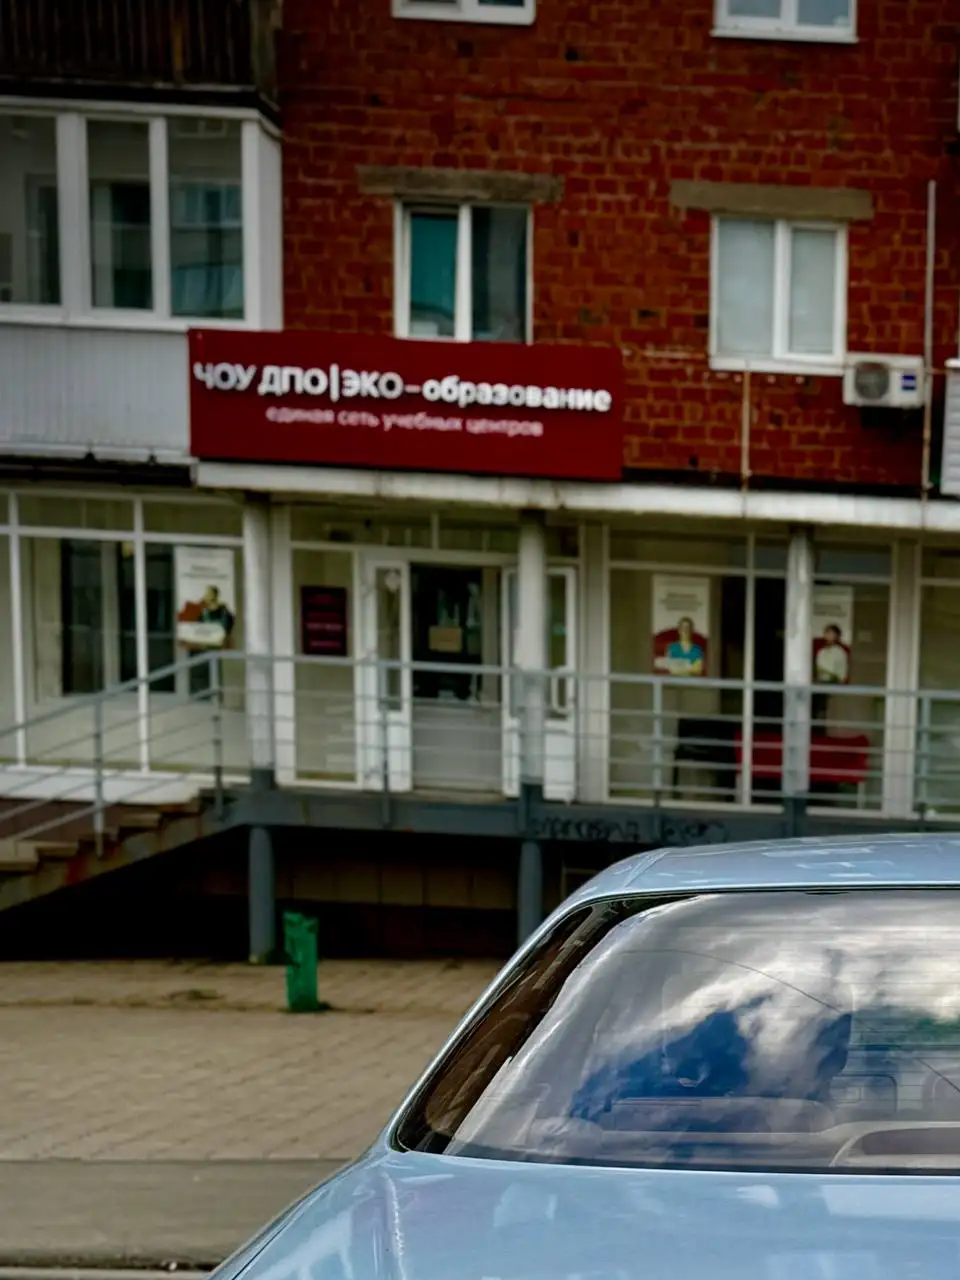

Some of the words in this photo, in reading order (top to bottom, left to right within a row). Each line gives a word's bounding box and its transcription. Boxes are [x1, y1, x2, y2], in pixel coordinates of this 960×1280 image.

[193, 361, 256, 391] ЧОУ
[337, 410, 380, 427] сеть
[382, 412, 463, 432] учебных
[465, 418, 544, 437] центров
